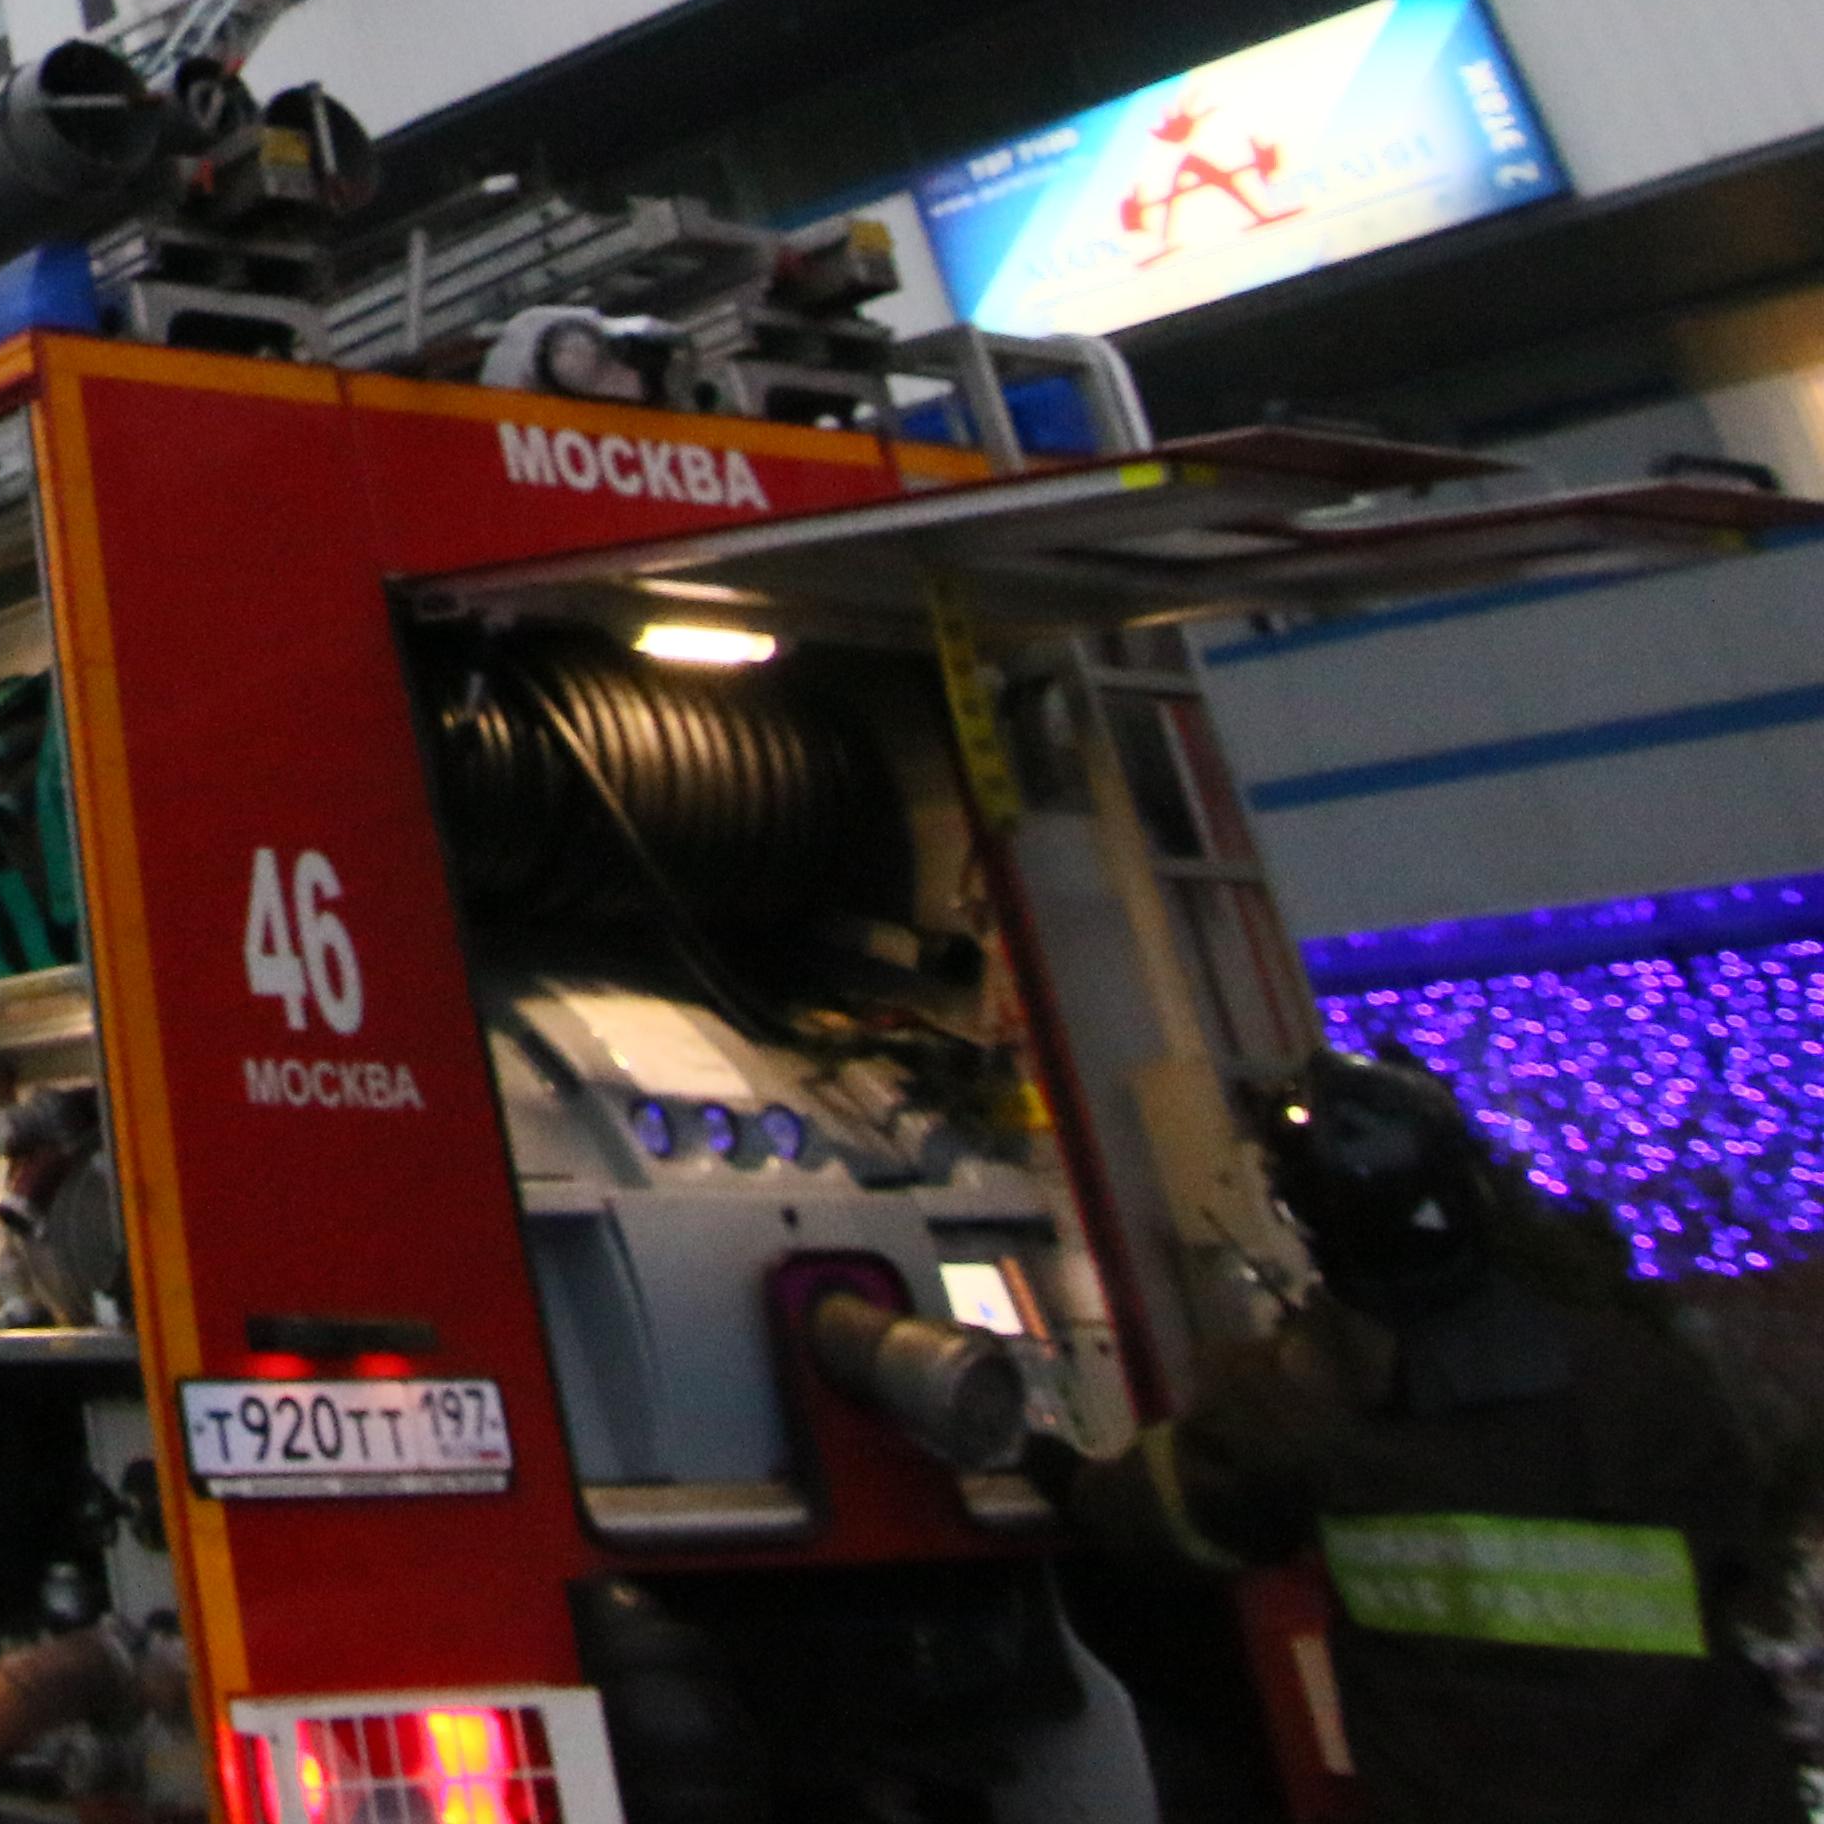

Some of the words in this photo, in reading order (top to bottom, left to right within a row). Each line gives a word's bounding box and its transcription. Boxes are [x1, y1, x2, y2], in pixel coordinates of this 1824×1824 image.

[497, 420, 769, 511] МОСКВА
[244, 847, 362, 1035] 46
[246, 1059, 422, 1109] МОСКВА
